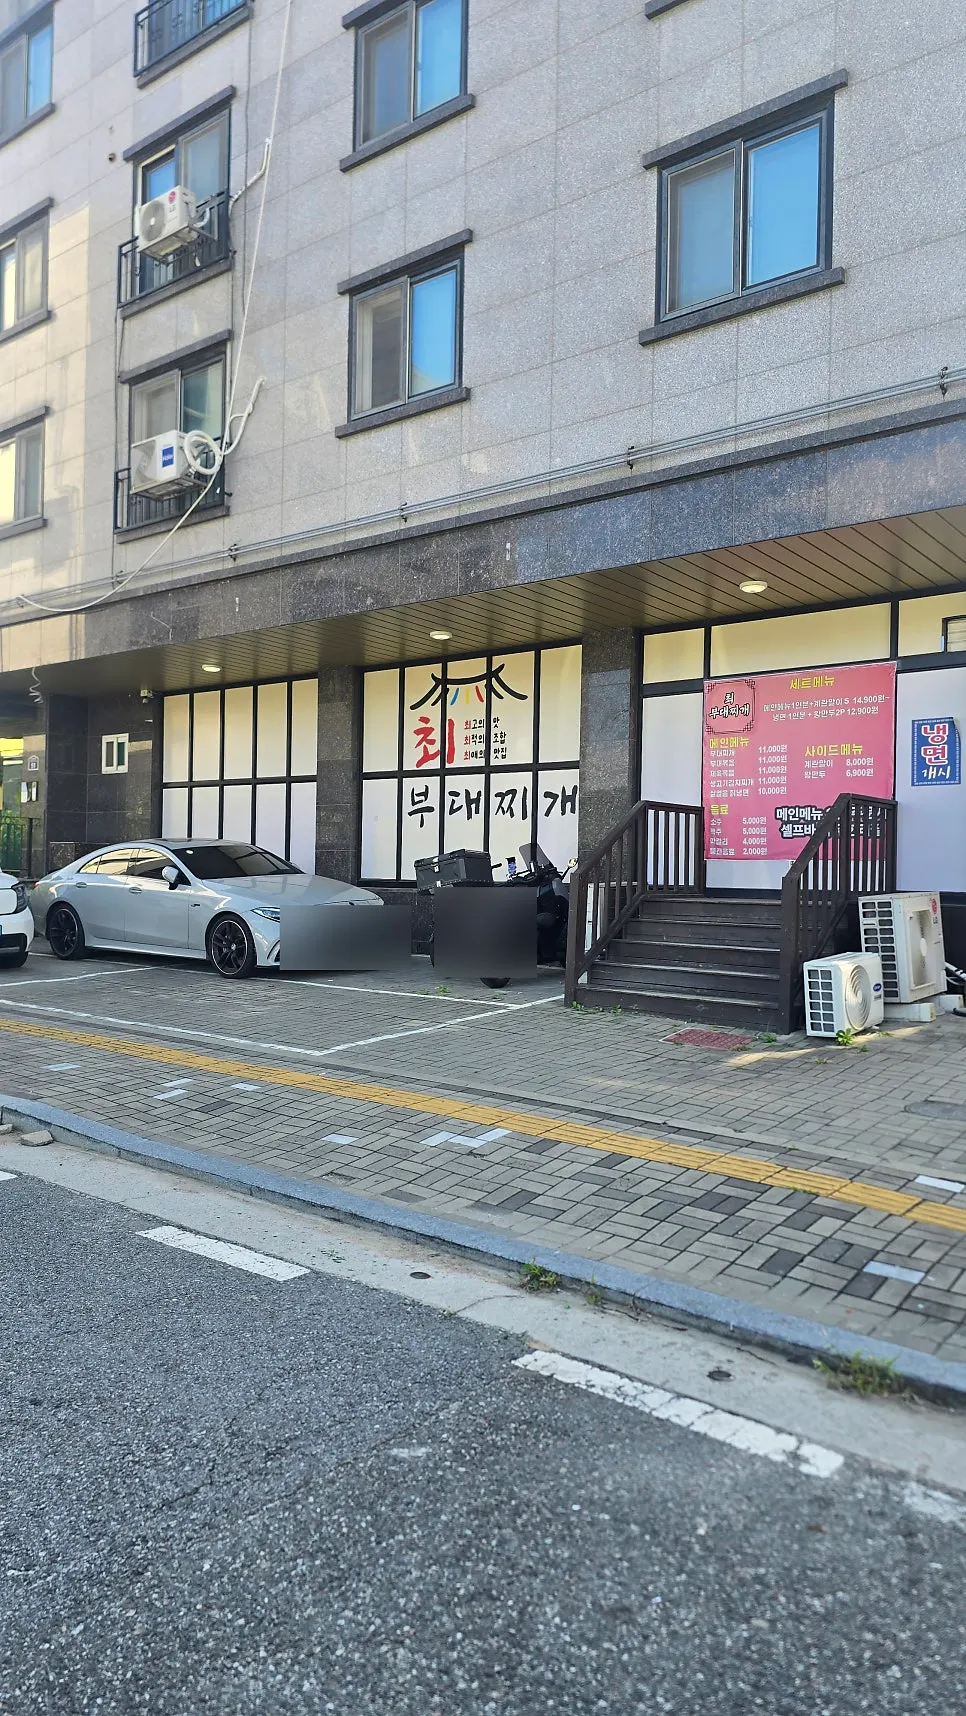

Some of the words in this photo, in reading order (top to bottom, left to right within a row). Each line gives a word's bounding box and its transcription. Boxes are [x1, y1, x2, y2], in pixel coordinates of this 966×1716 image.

[790, 675, 835, 690] 세트메뉴
[724, 692, 735, 704] 최
[709, 704, 750, 718] 부대찌개
[847, 705, 879, 716] 12,900원
[464, 718, 485, 730] 최고의
[492, 717, 500, 729] 맛
[412, 716, 456, 768] 최
[463, 734, 485, 746] 최적의
[493, 731, 507, 744] 조합
[709, 736, 750, 749] 메인메뉴
[921, 723, 949, 766] 냉면
[463, 750, 485, 761] 최애의
[493, 747, 507, 759] 맛집
[758, 744, 788, 753] 11,000원
[804, 743, 863, 757] 사이드메뉴
[758, 755, 787, 764] 11,000원
[804, 759, 834, 768] 계란말이
[846, 757, 874, 767] 8,000원
[758, 765, 787, 774] 11,000원
[846, 768, 874, 777] 6,900원
[921, 765, 951, 779] 개시
[758, 776, 787, 785] 11,000원
[758, 786, 787, 796] 10,000원
[407, 784, 578, 828] 부대찌개
[710, 804, 729, 815] 음료
[775, 806, 824, 821] 메인메뉴
[742, 816, 767, 825] 5,000원
[742, 826, 767, 835] 5,000원
[781, 823, 817, 838] 셀프바
[742, 837, 767, 845] 4,000원
[742, 847, 768, 856] 2,000원
